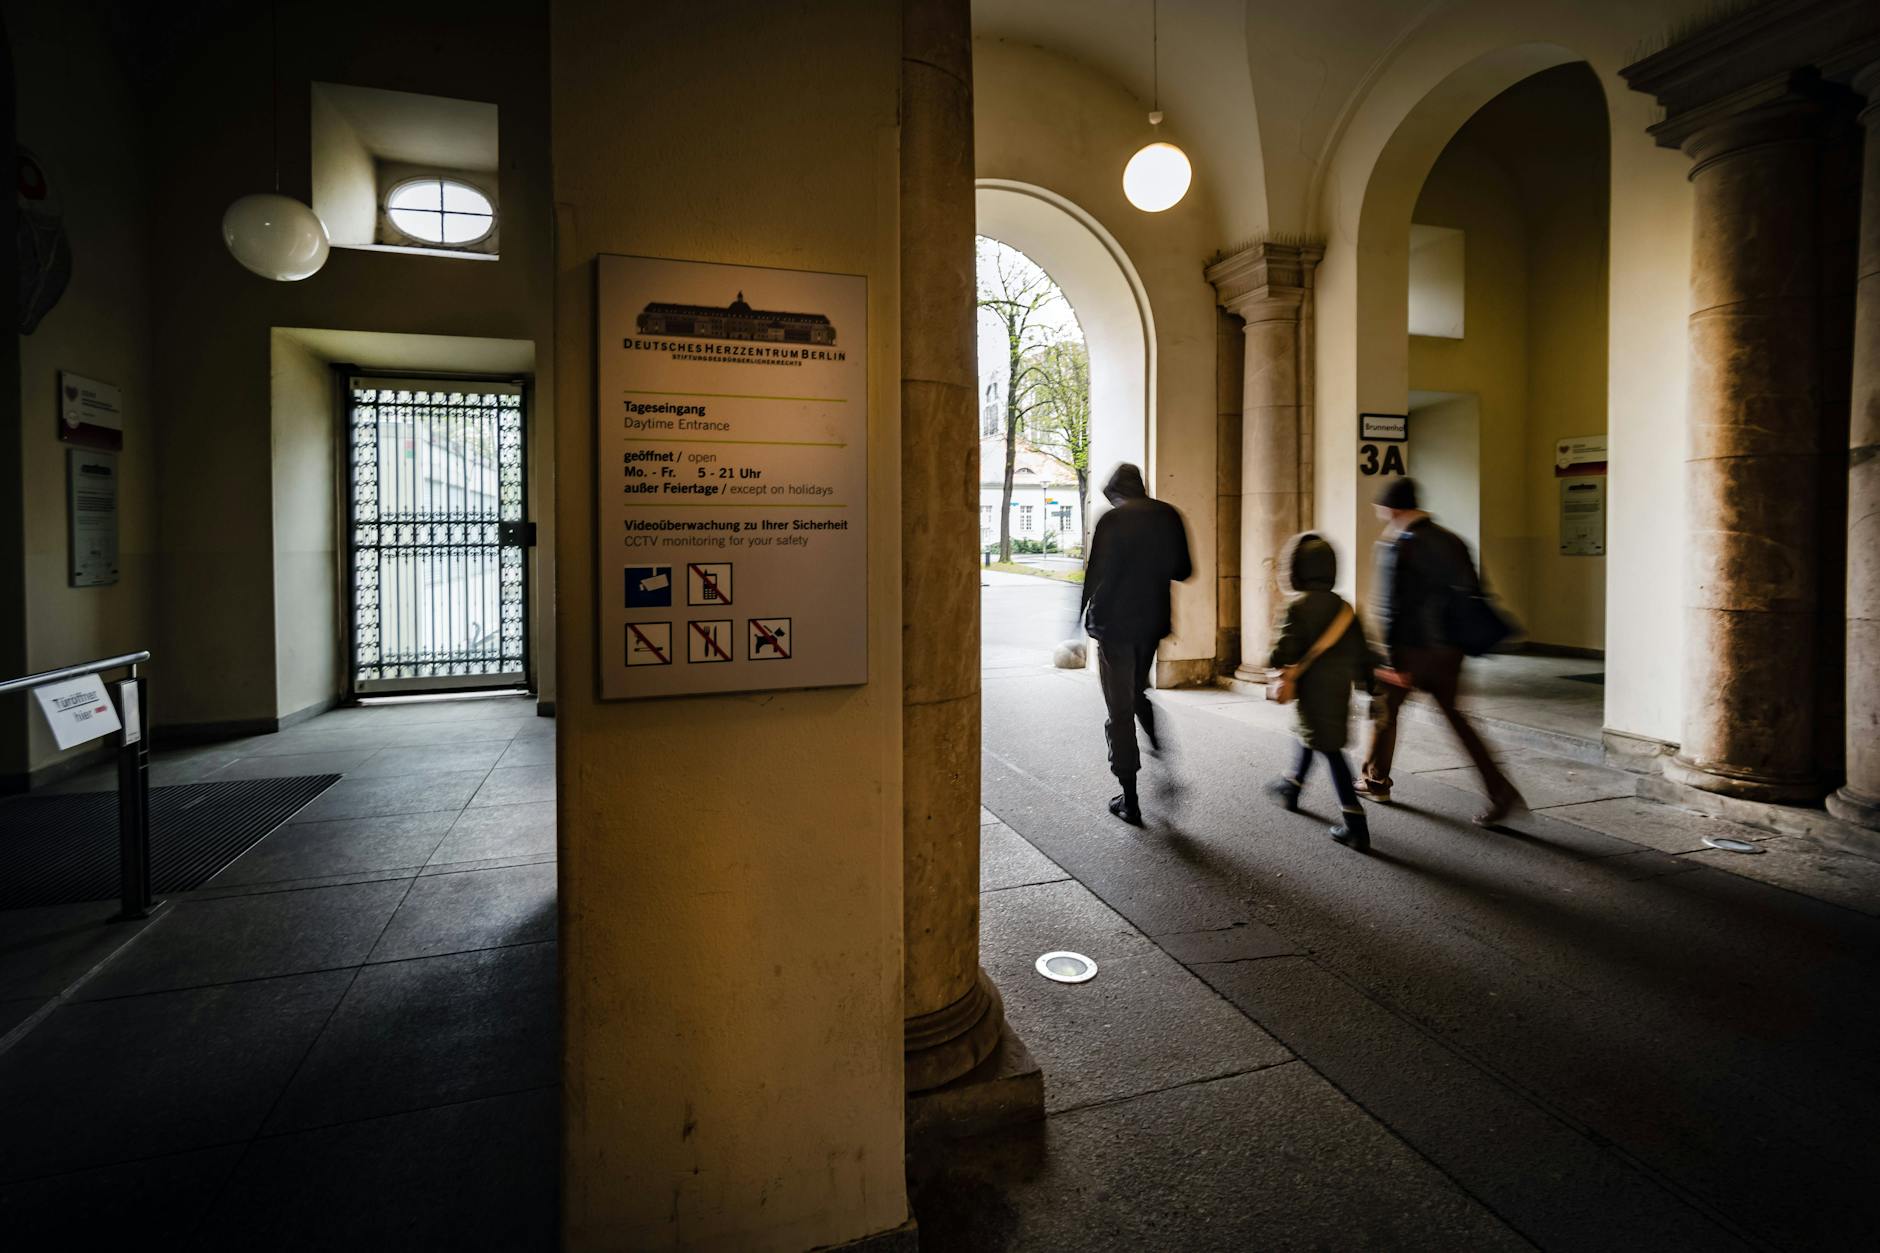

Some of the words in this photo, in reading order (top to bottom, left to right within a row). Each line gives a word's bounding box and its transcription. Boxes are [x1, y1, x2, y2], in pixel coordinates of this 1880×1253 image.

[624, 401, 706, 416] Tageseingang
[624, 417, 674, 431] Daytime
[678, 418, 730, 431] Entrance
[624, 450, 673, 464] geöffnet
[688, 454, 716, 464] open
[1360, 443, 1405, 476] 3A
[624, 466, 647, 478] Mo.
[661, 466, 676, 478] Fr.
[698, 467, 706, 478] 5
[719, 467, 735, 479] 21
[740, 467, 762, 479] Uhr
[624, 483, 658, 494] außer
[663, 483, 719, 496] Feiertage
[730, 485, 766, 496] except
[770, 486, 784, 495] on
[788, 484, 833, 497] holidays
[624, 519, 740, 533] Videoüberwachung
[744, 522, 757, 531] zu
[762, 520, 789, 530] Ihrer
[793, 520, 848, 531] Sicherheit
[624, 536, 657, 547] CCTV
[662, 536, 726, 548] monitoring
[729, 536, 744, 546] for
[748, 536, 772, 548] your
[776, 535, 808, 548] safety
[73, 709, 92, 722] hier
